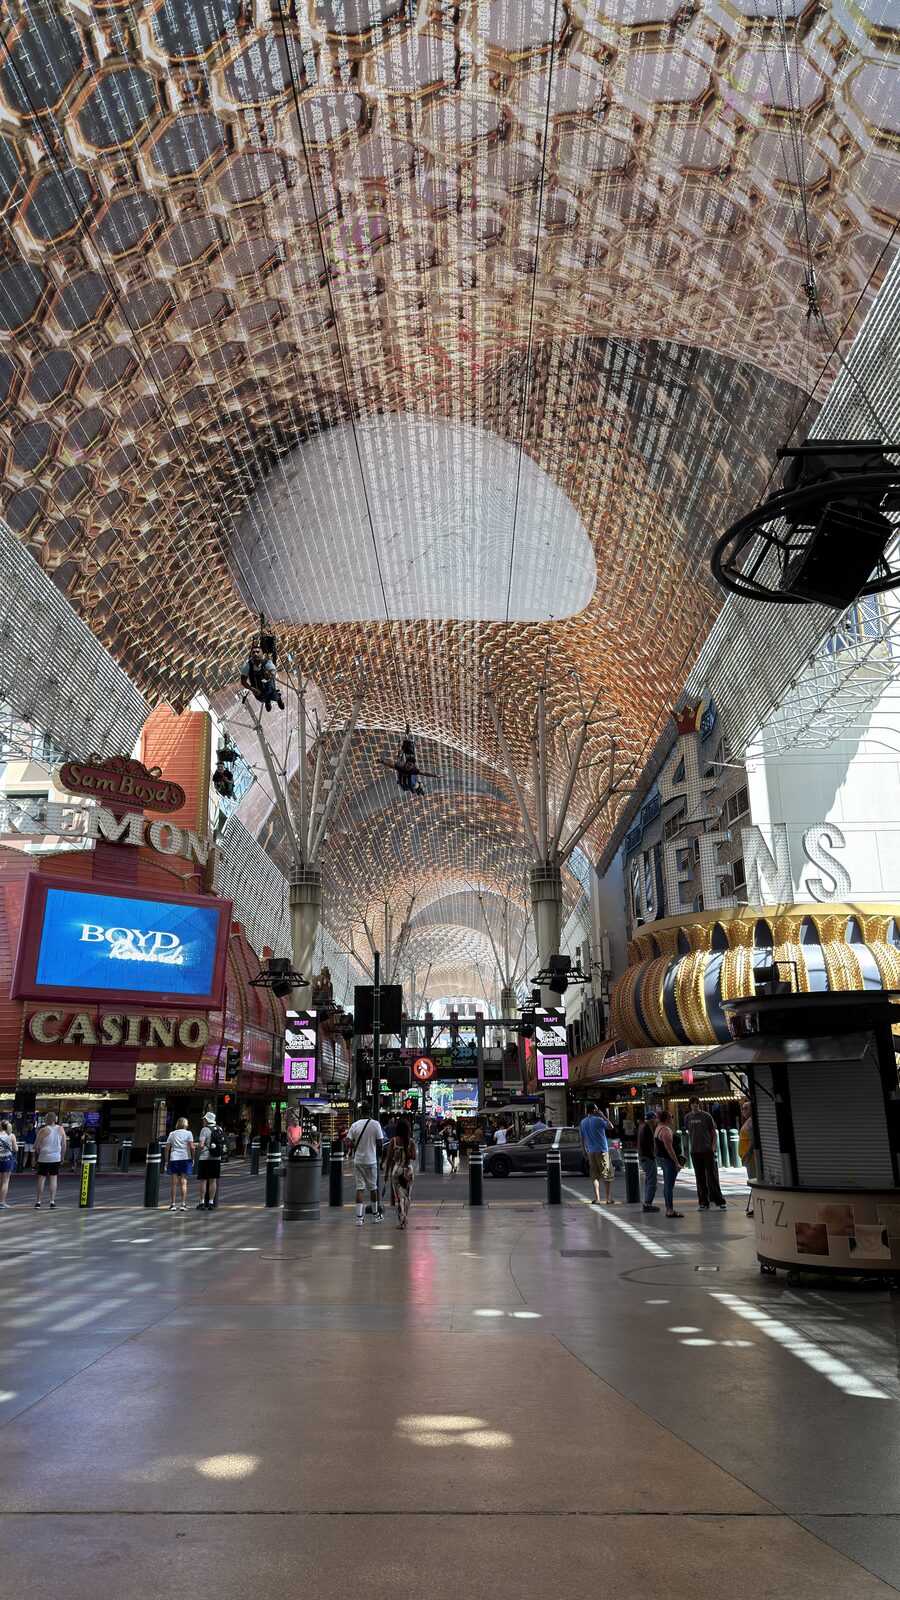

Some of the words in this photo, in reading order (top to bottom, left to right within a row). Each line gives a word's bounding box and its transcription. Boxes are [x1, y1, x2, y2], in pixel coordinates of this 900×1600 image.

[67, 765, 116, 791] Sam
[119, 775, 179, 805] Boyd's
[659, 732, 724, 823] 4
[80, 924, 180, 948] BOYD
[29, 1010, 210, 1049] CASINO
